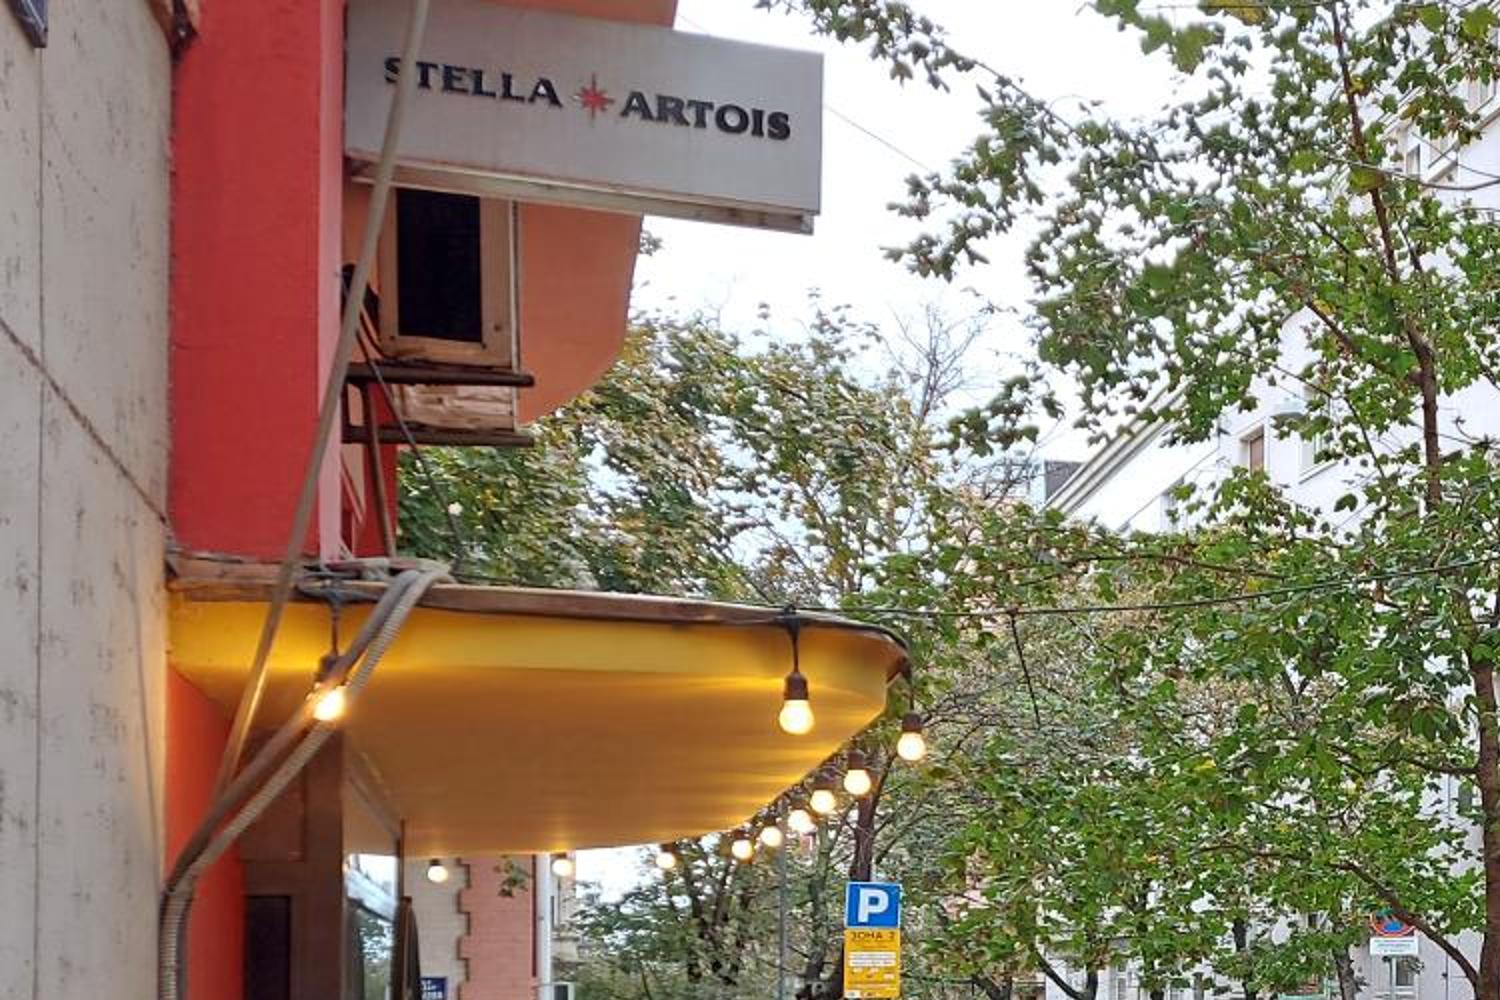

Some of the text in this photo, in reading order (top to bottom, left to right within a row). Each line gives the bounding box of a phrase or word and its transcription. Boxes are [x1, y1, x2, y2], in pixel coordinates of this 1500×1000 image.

[384, 56, 792, 142] STELLA ARTOIS
[857, 887, 890, 923] P
